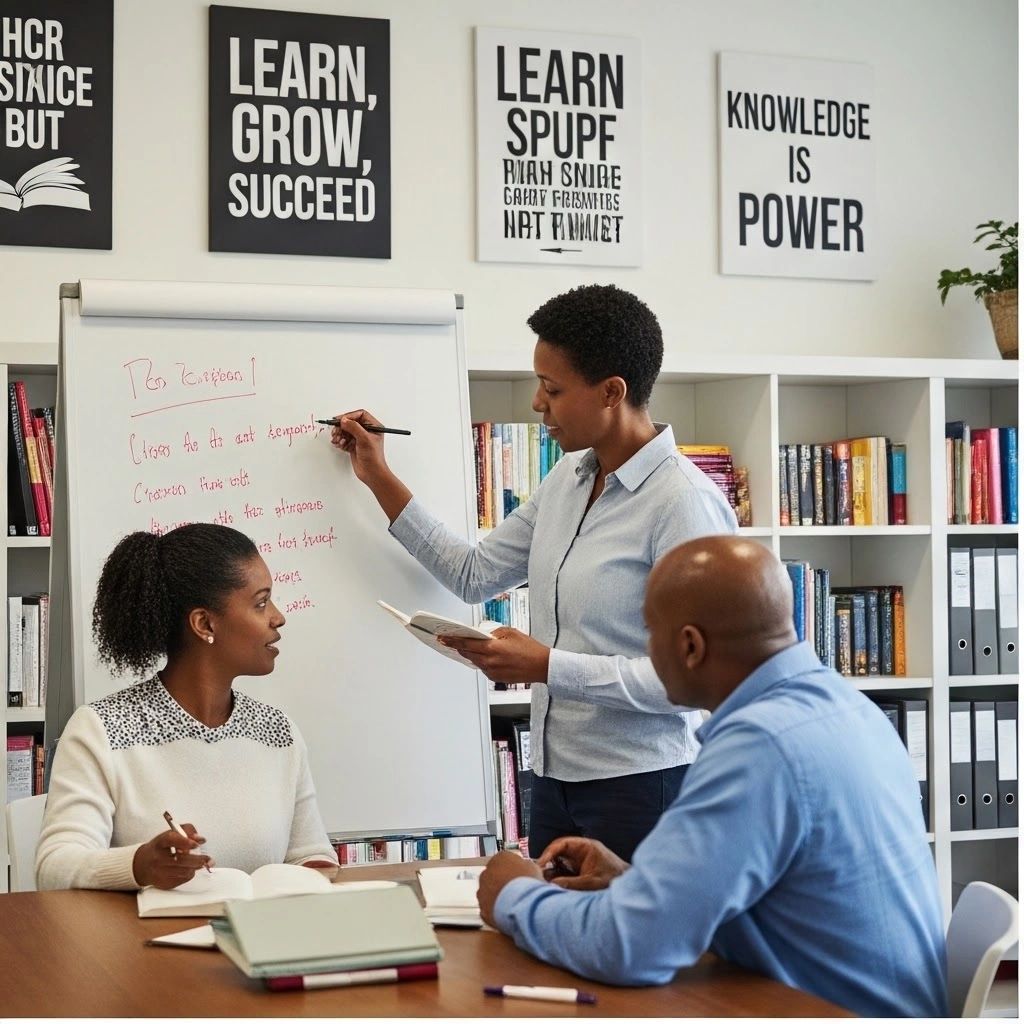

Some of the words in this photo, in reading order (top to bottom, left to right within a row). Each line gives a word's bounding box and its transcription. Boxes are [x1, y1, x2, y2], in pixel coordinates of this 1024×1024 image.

[2, 17, 64, 61] HCR
[229, 37, 377, 111] LEARN,
[497, 45, 624, 109] LEARN
[5, 107, 65, 151] BUT
[232, 102, 372, 176] GROW,
[506, 107, 617, 161] SPUPF
[727, 90, 871, 140] KNOWLEDGE
[788, 146, 811, 184] IS
[228, 173, 376, 222] SUCCEED
[738, 192, 864, 252] POWER
